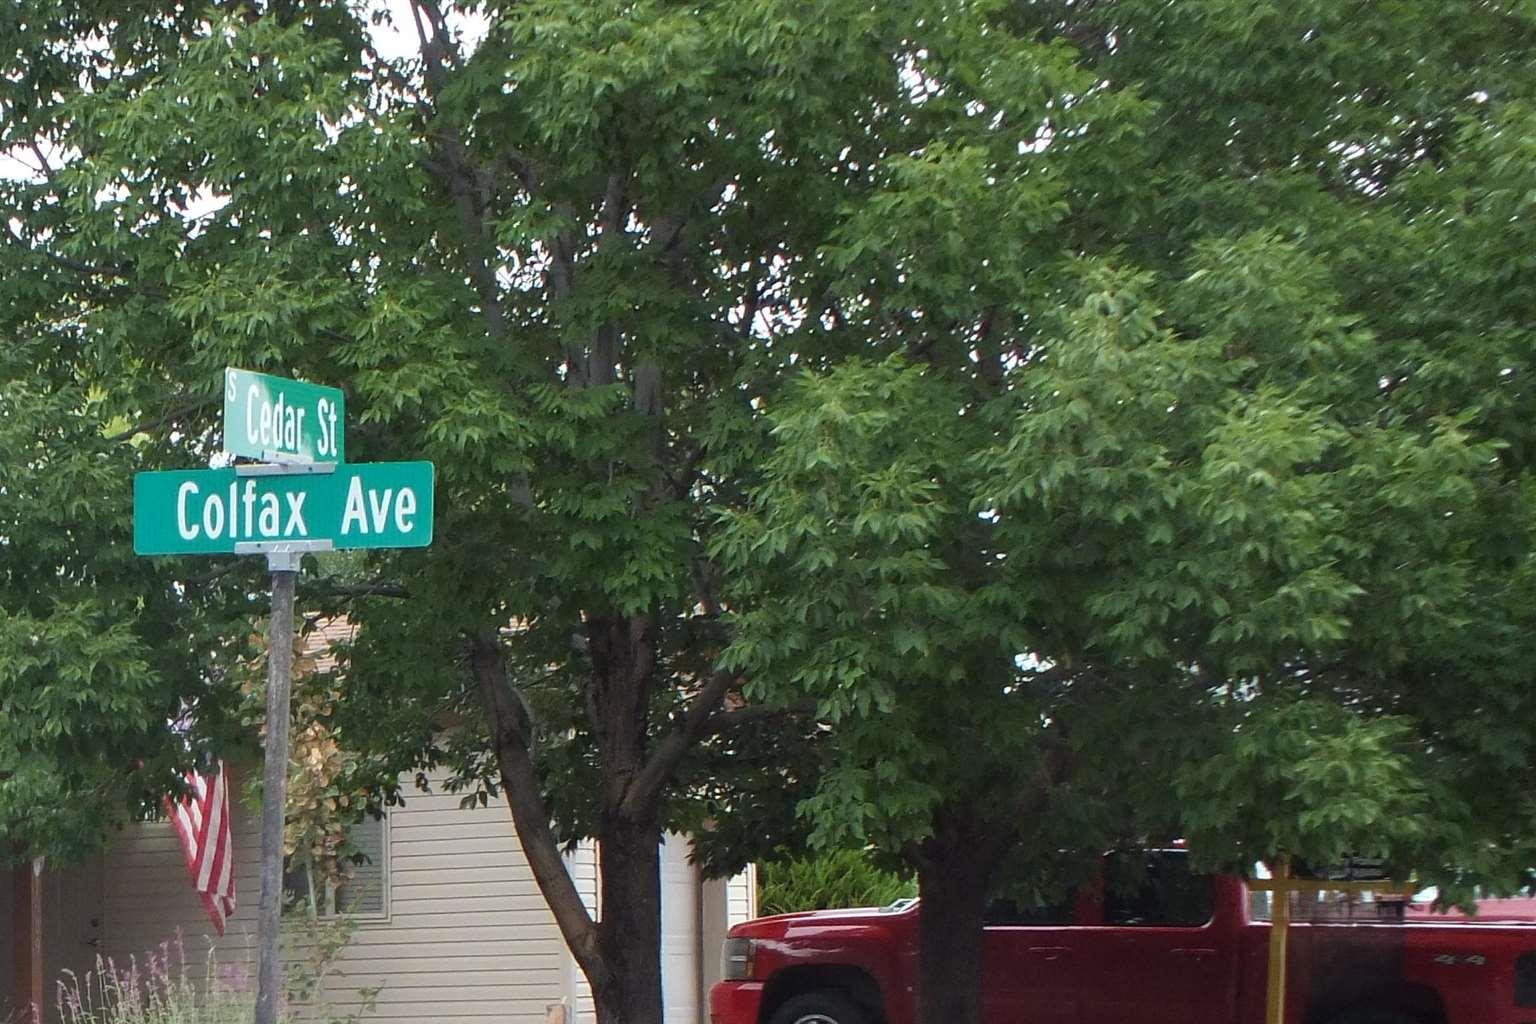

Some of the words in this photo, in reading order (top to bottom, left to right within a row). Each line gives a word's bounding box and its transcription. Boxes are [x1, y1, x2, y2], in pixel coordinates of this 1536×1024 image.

[227, 371, 238, 402] S
[246, 384, 305, 452] Cedar
[316, 398, 338, 457] St
[177, 480, 308, 540] Colfax
[340, 476, 417, 536] Ave
[1432, 953, 1487, 966] 44
